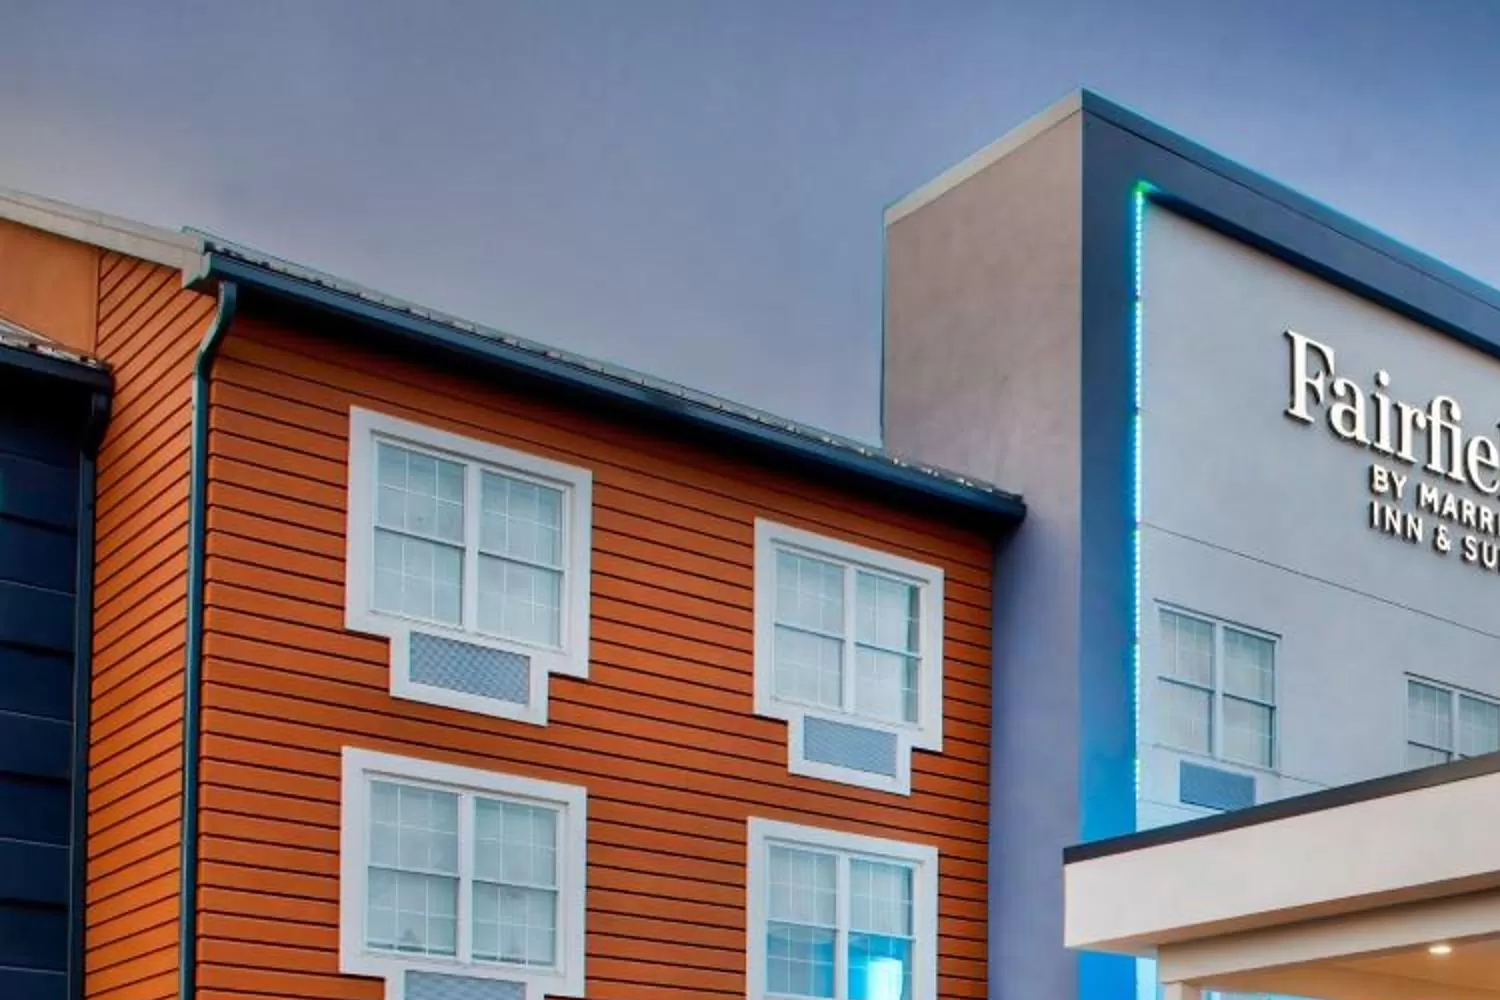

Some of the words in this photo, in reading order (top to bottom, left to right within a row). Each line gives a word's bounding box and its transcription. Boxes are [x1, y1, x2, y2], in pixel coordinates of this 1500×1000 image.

[1370, 464, 1407, 498] BY
[1369, 501, 1423, 542] INN
[1434, 524, 1452, 552] &
